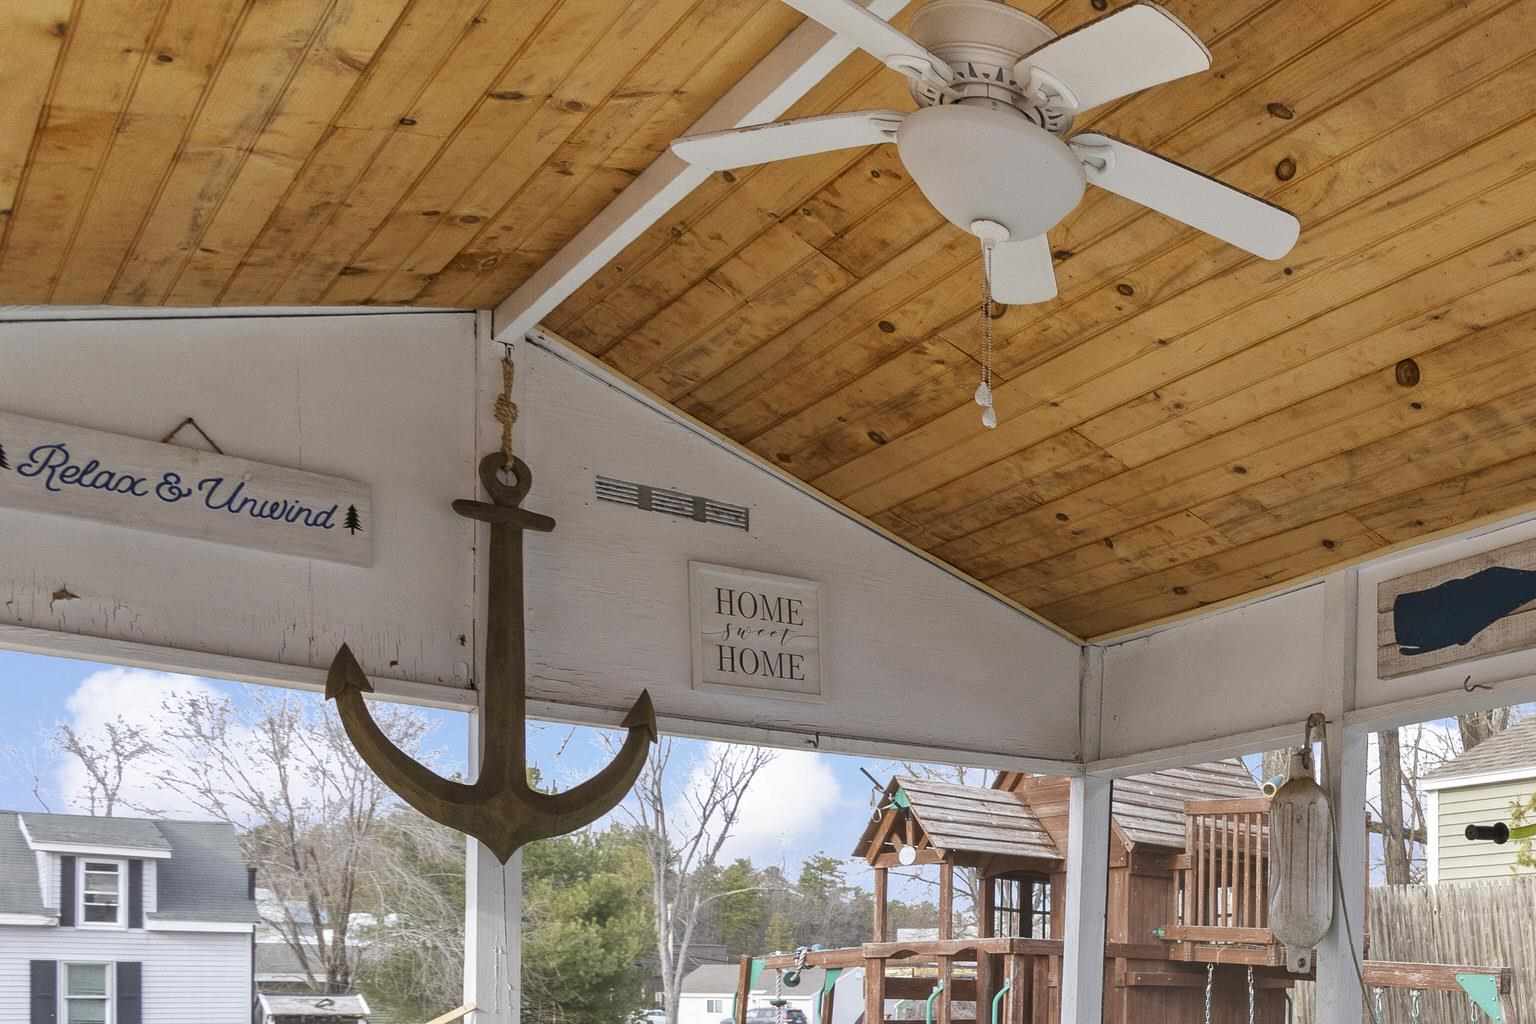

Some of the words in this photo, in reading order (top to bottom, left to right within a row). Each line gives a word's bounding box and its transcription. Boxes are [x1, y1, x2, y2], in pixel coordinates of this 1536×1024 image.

[17, 443, 149, 492] Relax
[155, 472, 192, 502] &
[198, 478, 339, 529] Unwind
[714, 586, 805, 626] HOME
[718, 622, 793, 647] sweet
[715, 644, 806, 681] HOME
